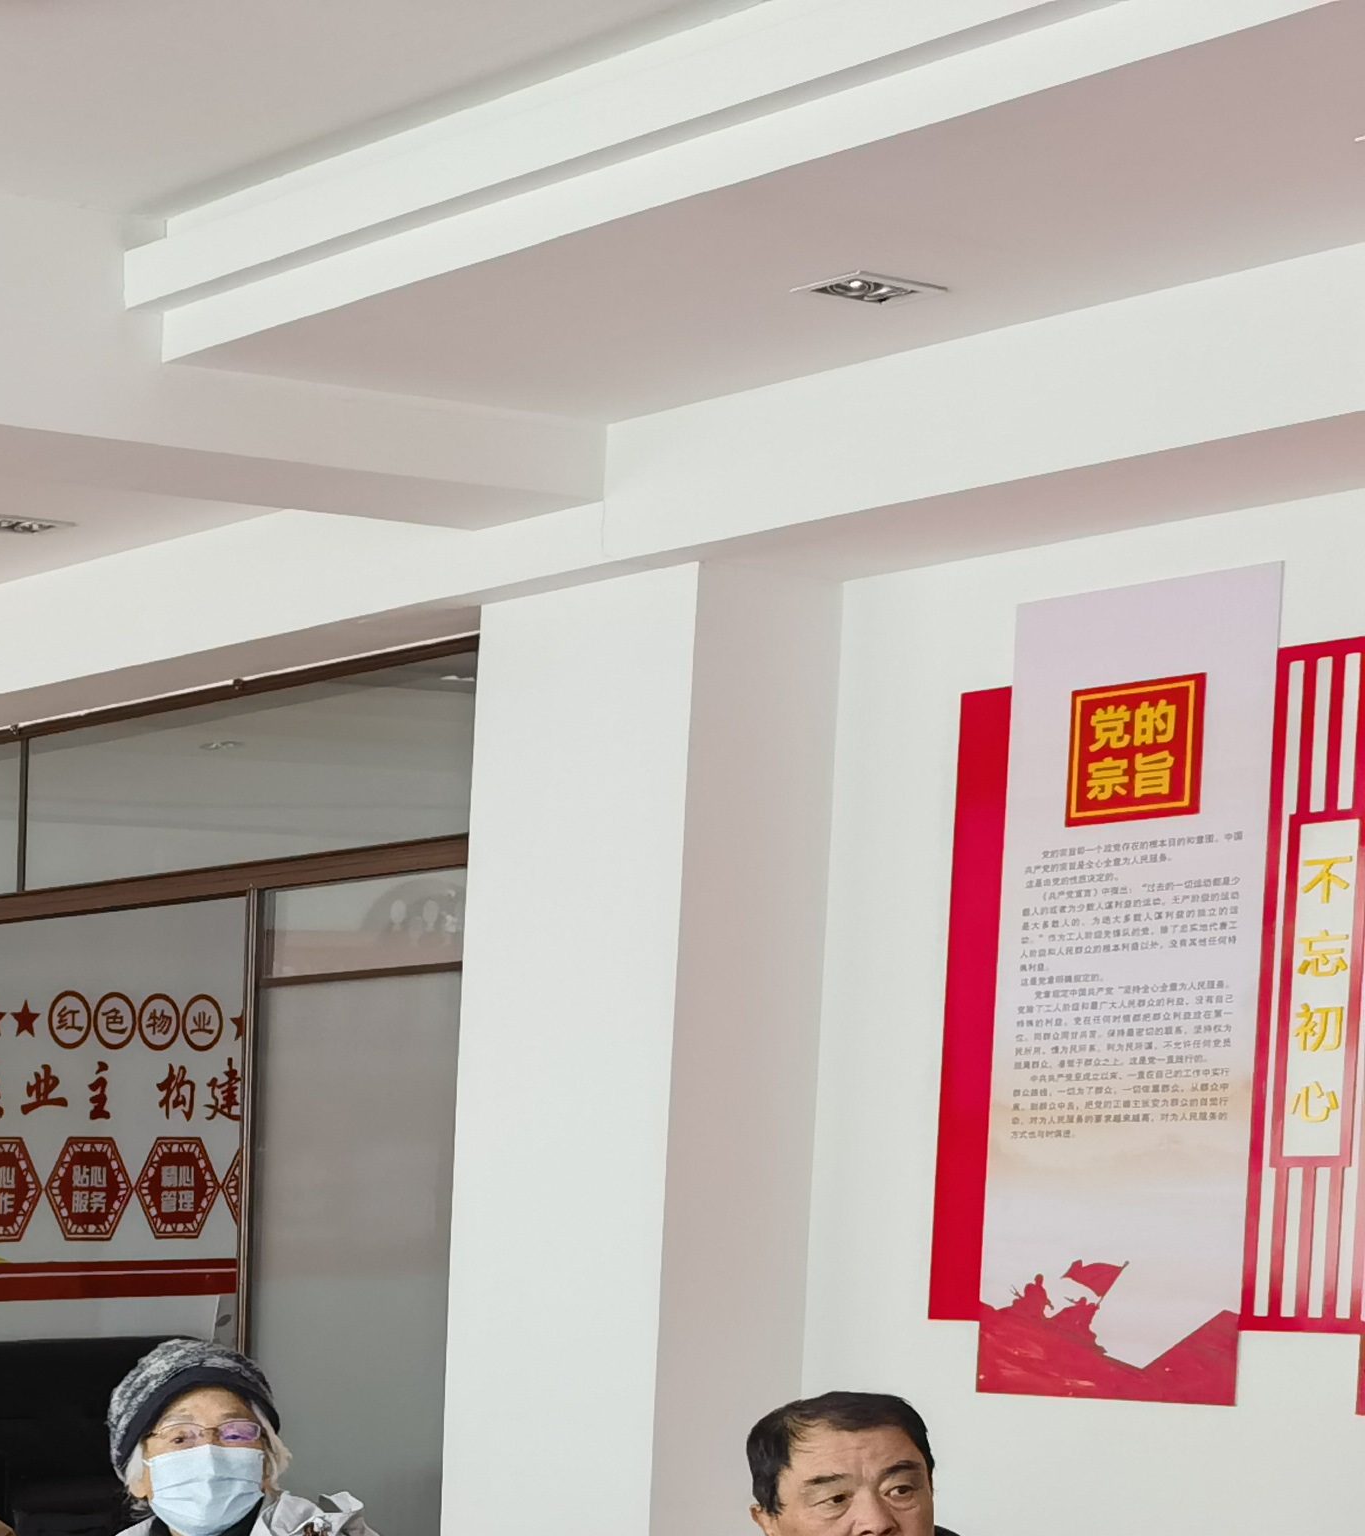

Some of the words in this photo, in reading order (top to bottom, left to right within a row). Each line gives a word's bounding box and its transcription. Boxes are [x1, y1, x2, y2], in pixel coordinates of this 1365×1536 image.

[1089, 699, 1177, 752] 党的
[1085, 751, 1175, 801] 宗旨
[1290, 855, 1354, 1124] 不忘初心
[54, 1002, 218, 1039] 红色物业
[156, 1057, 242, 1122] 构建
[72, 1165, 107, 1188] 贴心
[71, 1191, 107, 1213] 服务
